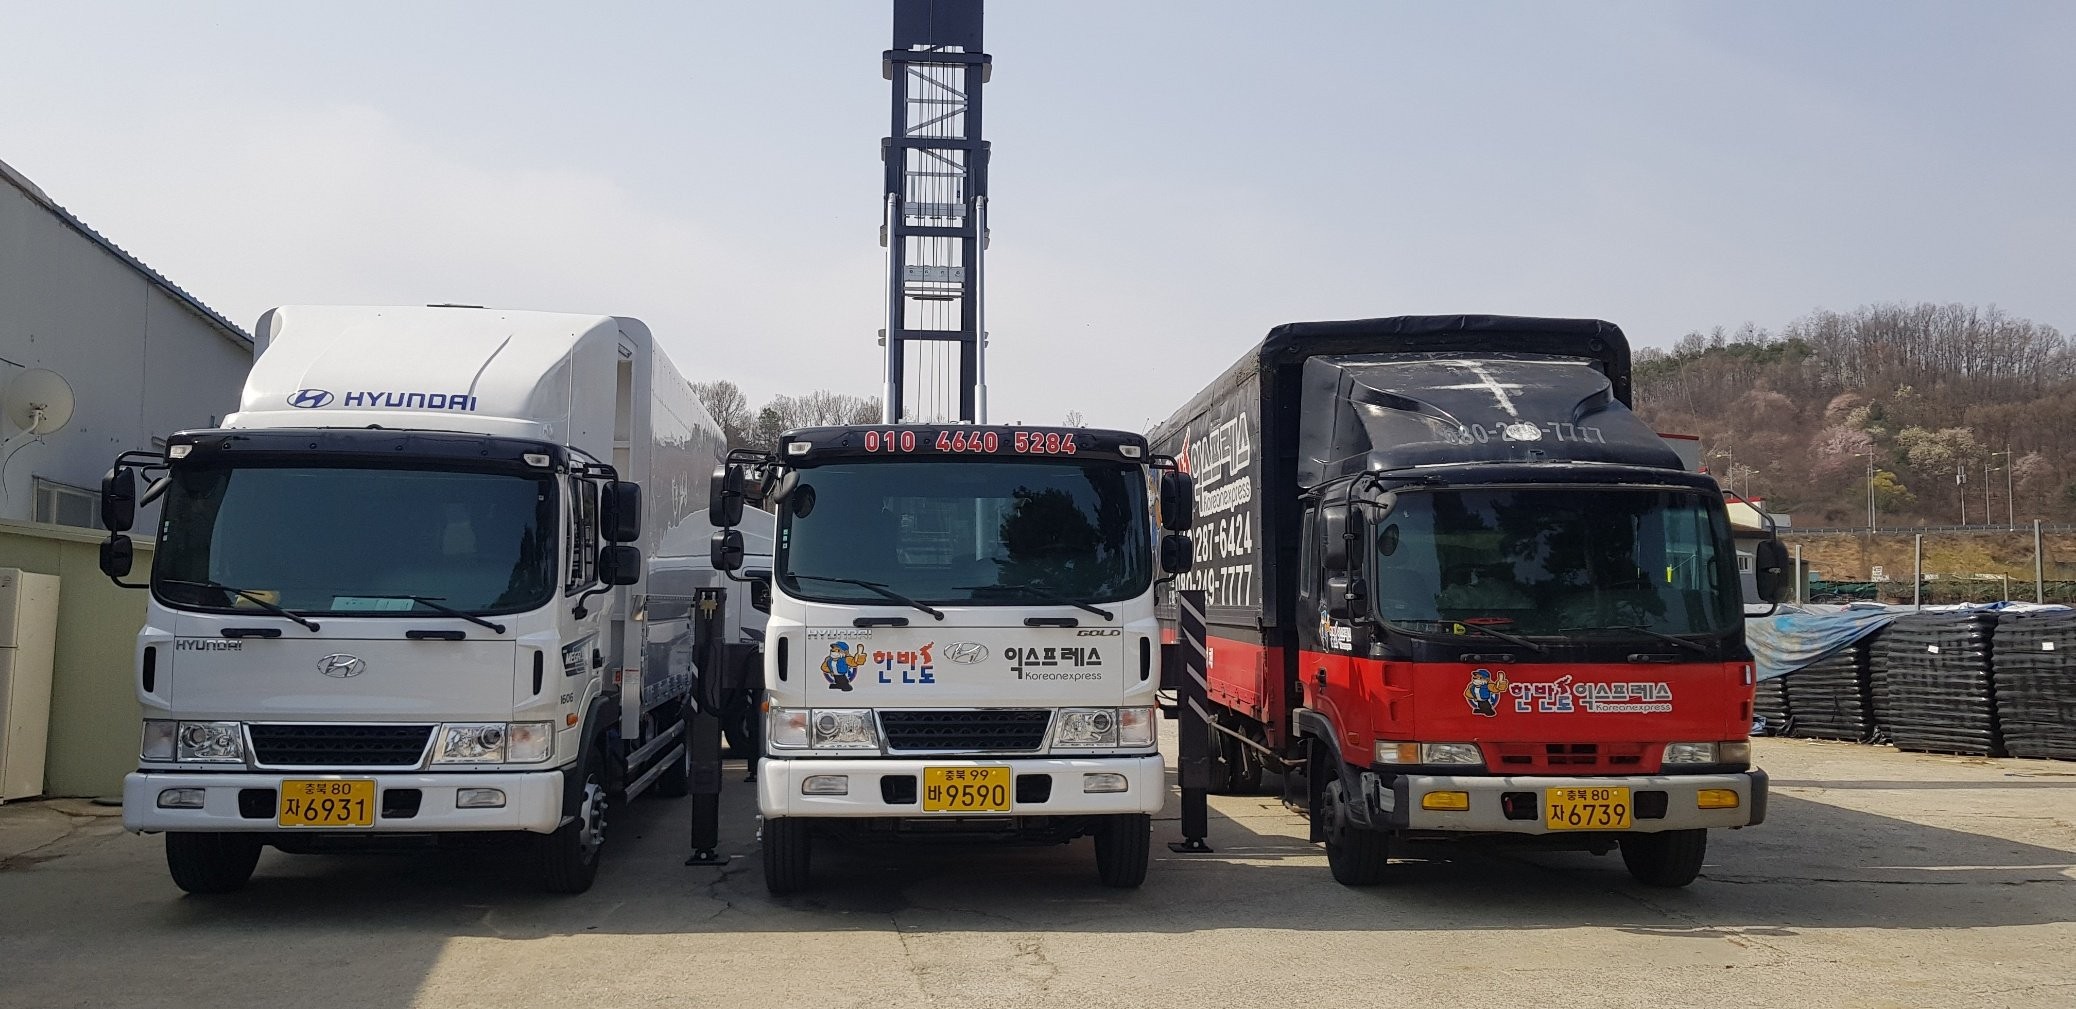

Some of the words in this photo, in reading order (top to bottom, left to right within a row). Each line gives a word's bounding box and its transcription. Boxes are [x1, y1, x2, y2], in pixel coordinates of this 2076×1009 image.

[344, 391, 477, 411] HYUNDAI
[865, 431, 916, 452] 010
[936, 431, 998, 452] 4640
[1015, 432, 1076, 454] 5284
[808, 629, 872, 639] HYUNDAI
[1077, 629, 1121, 637] GOLD
[176, 639, 242, 650] HYUNDAI
[873, 641, 935, 683] 한반도
[1004, 647, 1102, 680] 익스프레스
[1025, 671, 1102, 682] Koreanexpress
[1509, 675, 1574, 712] 한반도
[1574, 682, 1672, 712] 익스프레스
[1595, 703, 1672, 713] Koreanexpress
[944, 770, 965, 781] 충북
[970, 769, 989, 781] 99
[305, 783, 326, 794] 충북
[331, 783, 351, 795] 80
[1567, 789, 1587, 801] 충북
[1591, 789, 1609, 801] 80
